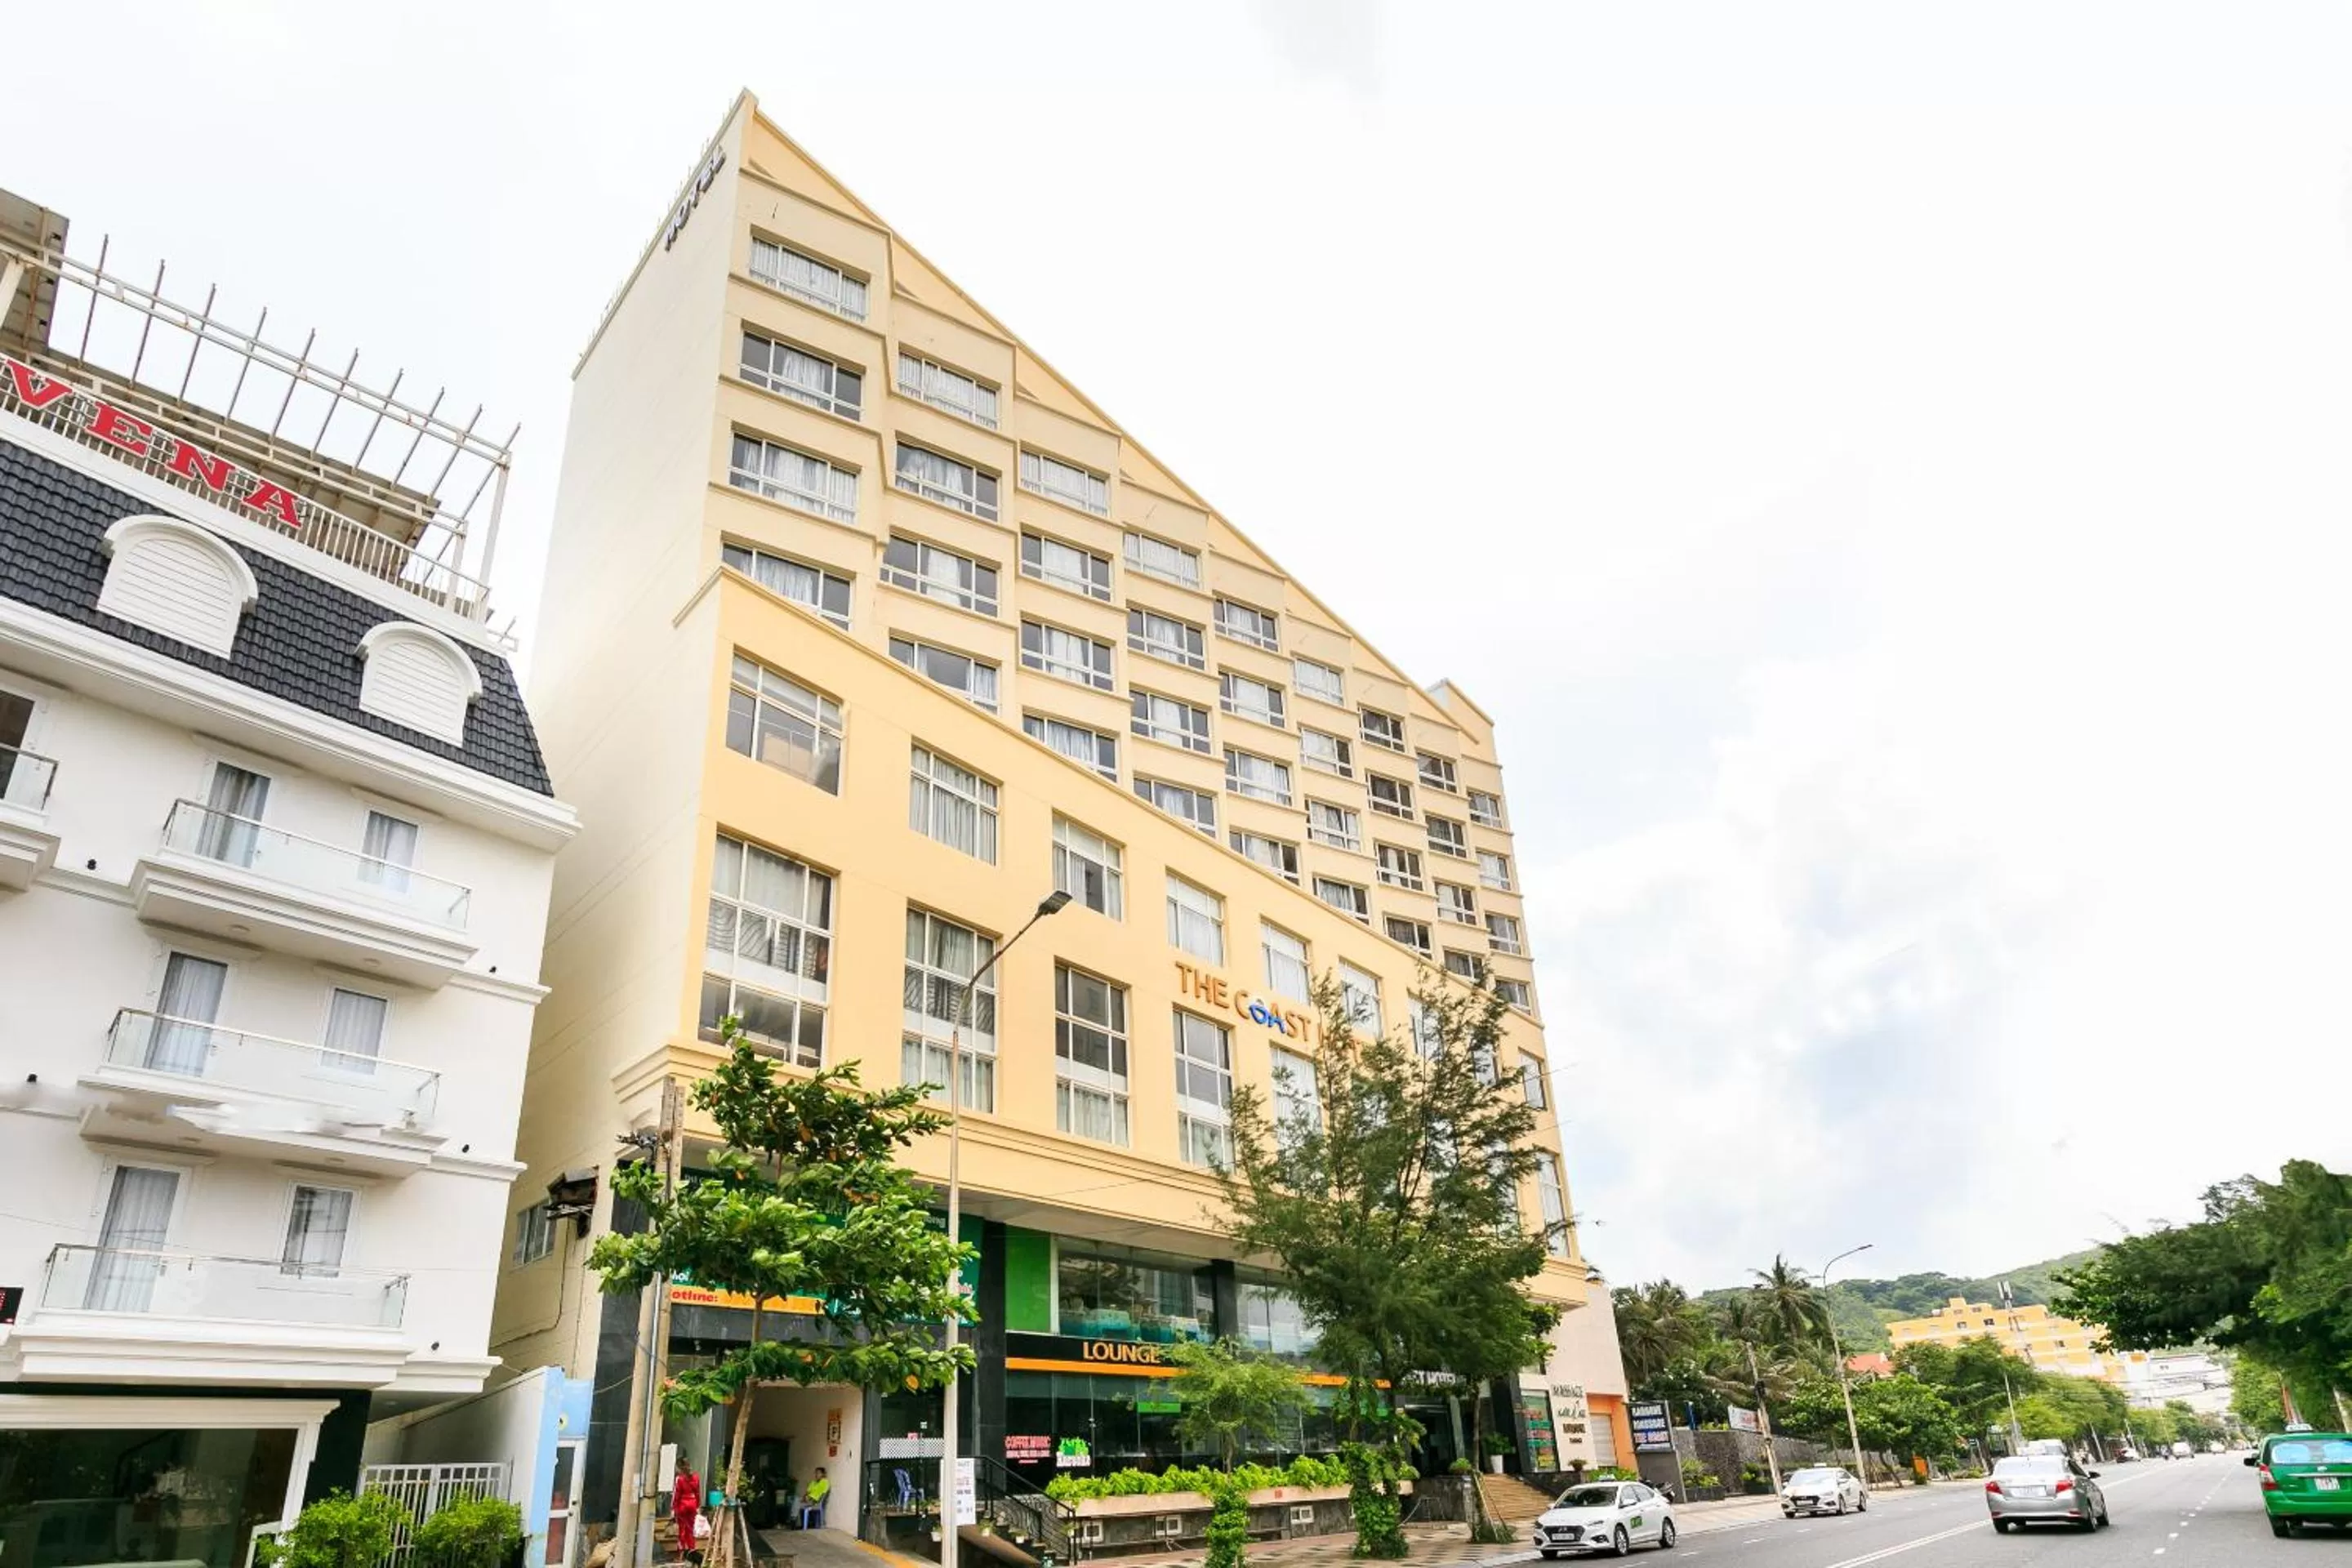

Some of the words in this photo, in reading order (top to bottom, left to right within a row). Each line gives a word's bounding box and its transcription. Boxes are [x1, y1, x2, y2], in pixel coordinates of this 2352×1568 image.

[5, 358, 304, 530] VENA
[1174, 960, 1230, 1009] THE
[1234, 988, 1312, 1042] COAST
[672, 1289, 719, 1303] otline:
[1082, 1341, 1161, 1364] LOUNGE
